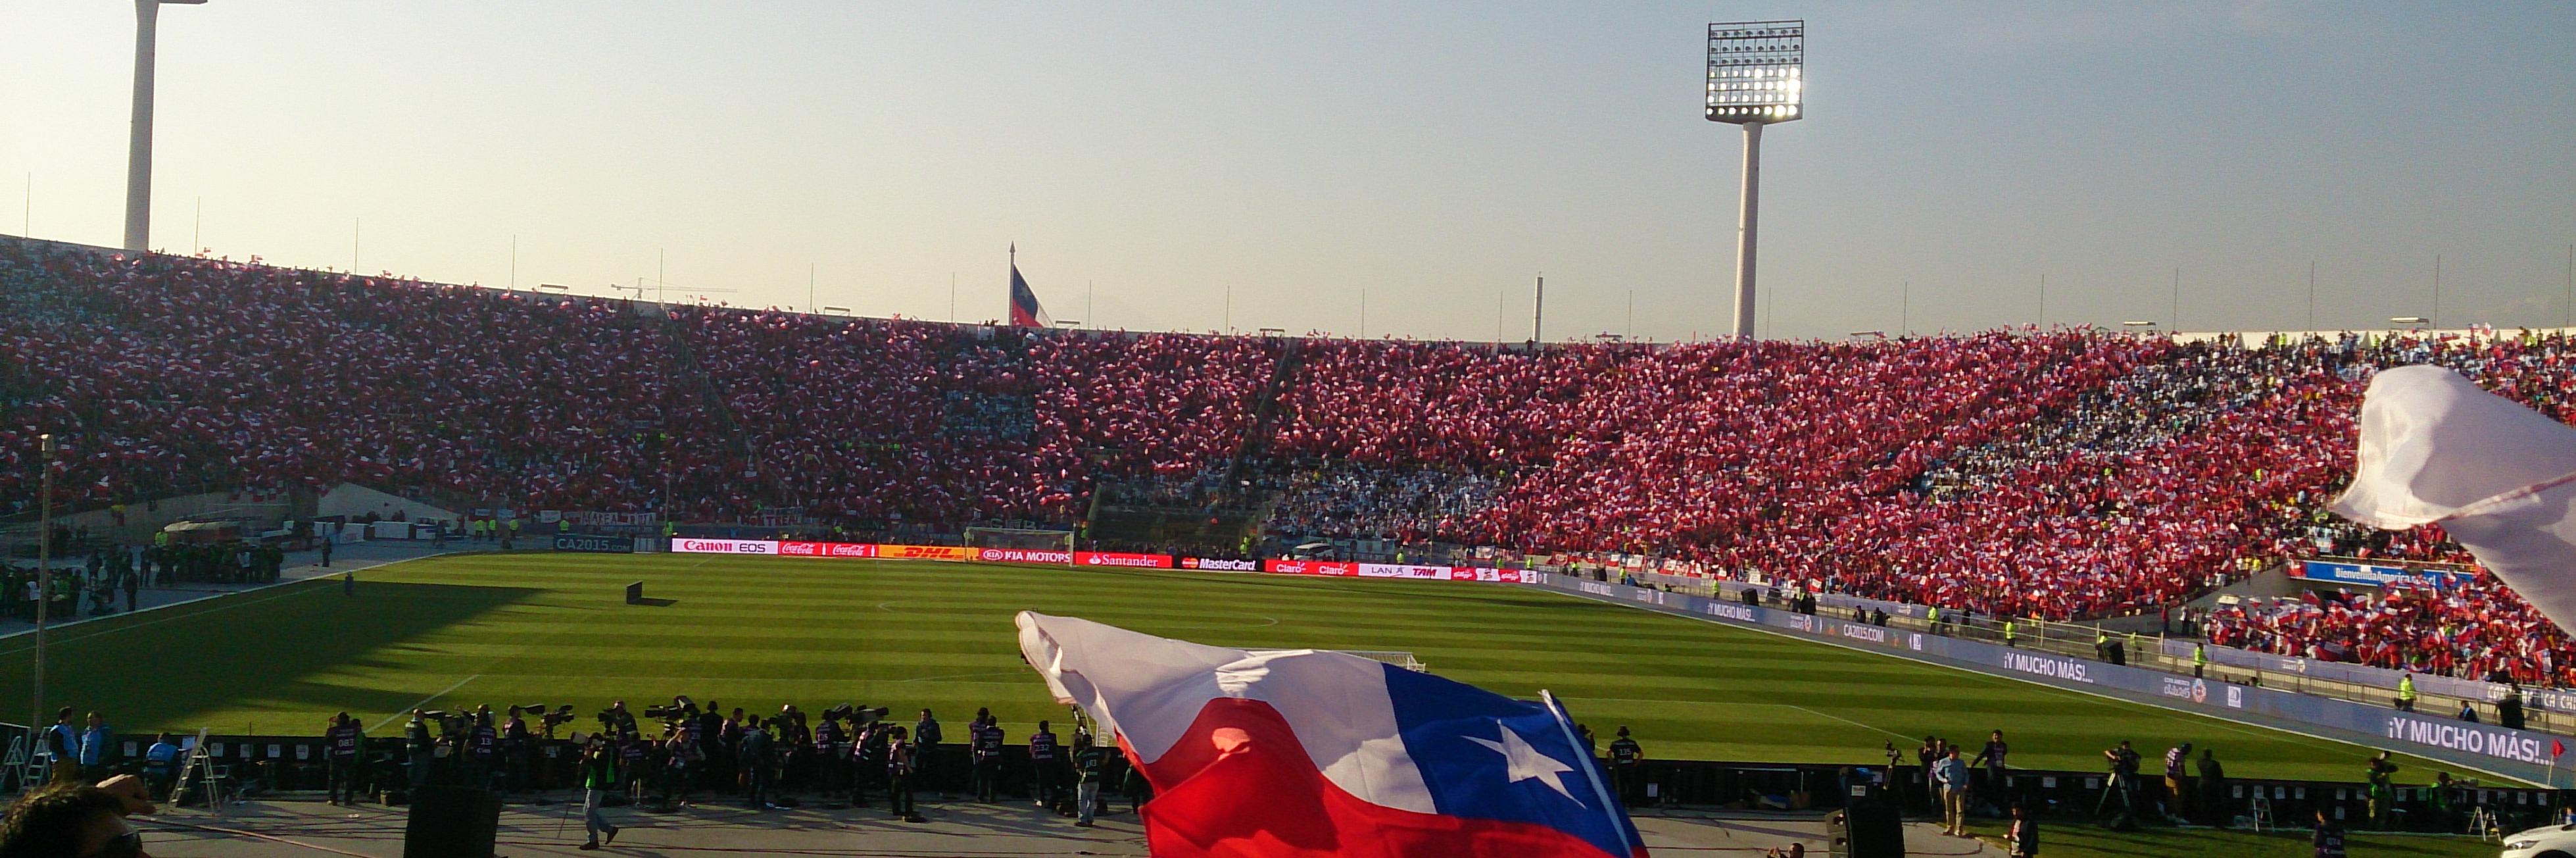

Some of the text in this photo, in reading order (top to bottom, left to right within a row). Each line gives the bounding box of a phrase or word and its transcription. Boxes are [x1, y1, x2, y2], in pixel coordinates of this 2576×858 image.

[684, 540, 766, 553] Canon EOS
[904, 547, 954, 558] DHL
[1005, 551, 1071, 563] KIA MOTORS
[1102, 554, 1158, 567] Santander
[1199, 558, 1255, 570] MasterCard
[1276, 563, 1302, 573] Claro
[1319, 565, 1344, 575] Claro
[1413, 568, 1437, 577] TAM
[1714, 603, 1736, 618] MUCHO
[1843, 624, 1884, 643] CA2015.COM
[2016, 654, 2056, 676] MUCHO
[2411, 720, 2483, 753] MUCHO
